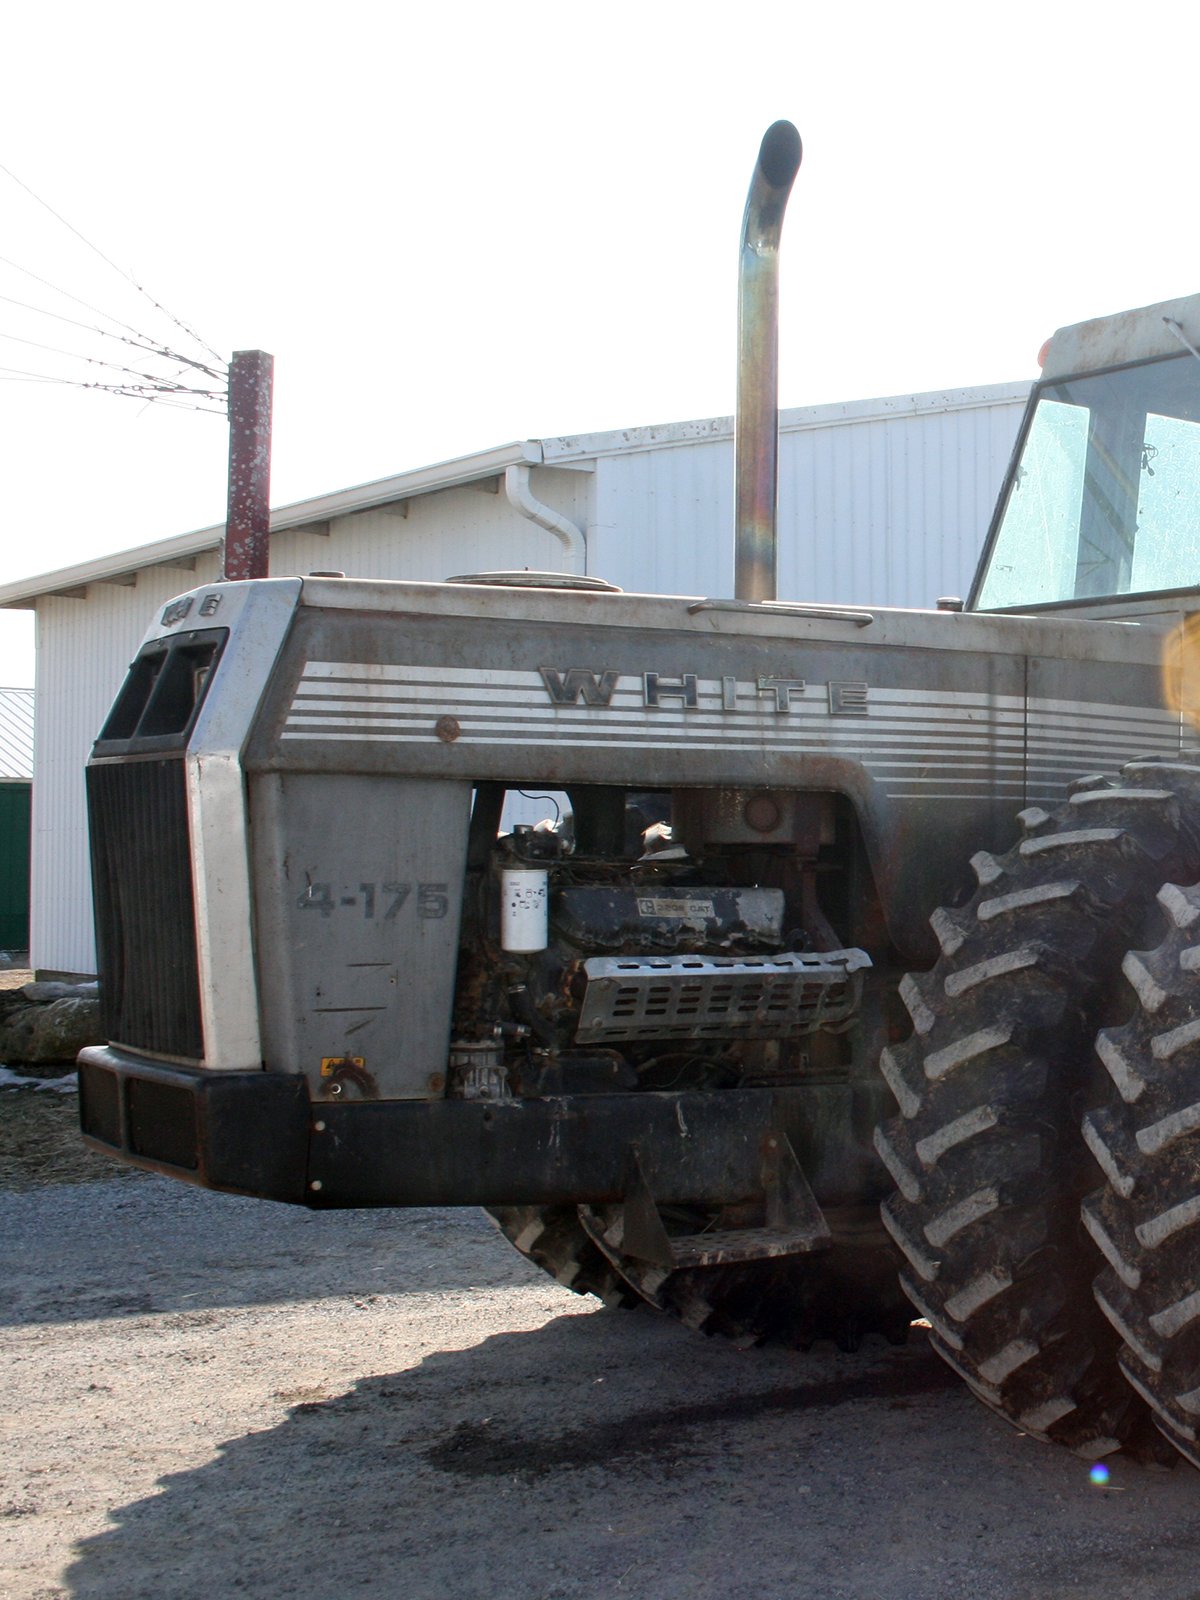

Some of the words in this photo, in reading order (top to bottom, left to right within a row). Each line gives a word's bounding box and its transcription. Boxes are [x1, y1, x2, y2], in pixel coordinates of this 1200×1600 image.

[539, 666, 870, 716] WHITE
[297, 882, 449, 920] 4-175
[690, 905, 710, 913] CAT
